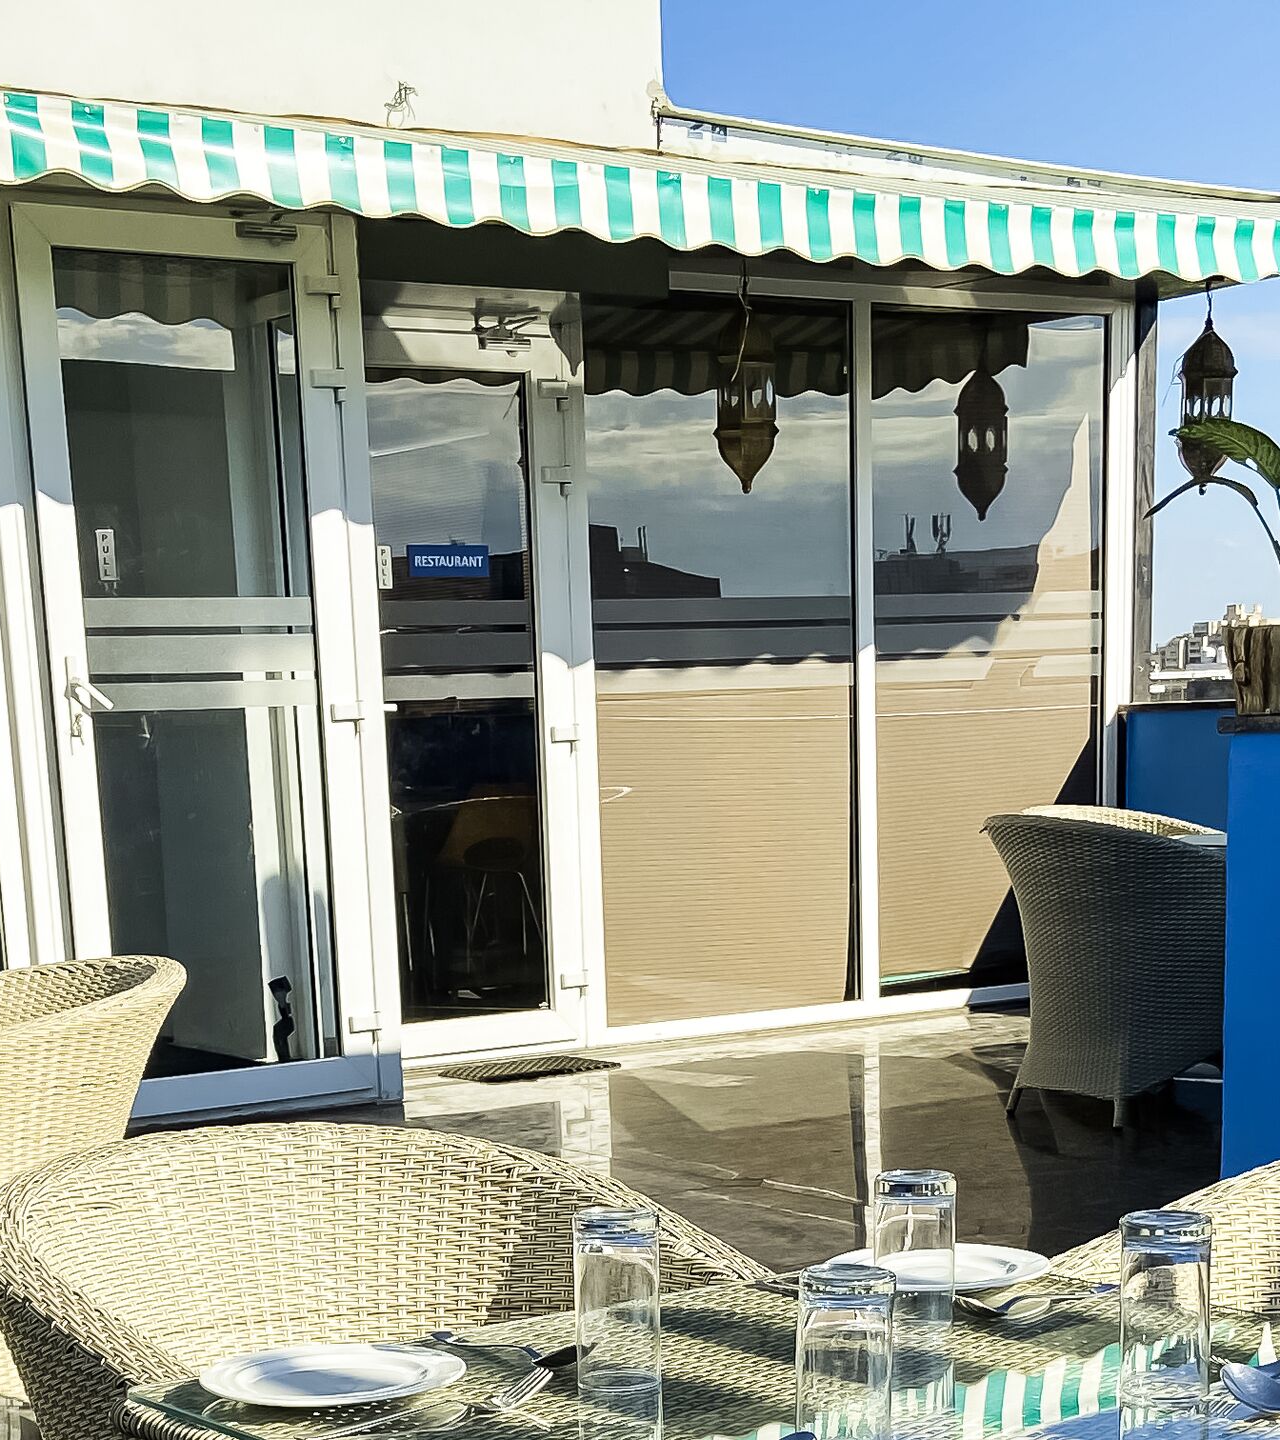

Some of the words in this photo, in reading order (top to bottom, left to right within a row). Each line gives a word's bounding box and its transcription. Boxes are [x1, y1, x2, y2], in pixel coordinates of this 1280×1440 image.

[101, 533, 111, 577] PULL
[380, 548, 388, 587] PULL
[414, 555, 484, 568] RESTAURANT
